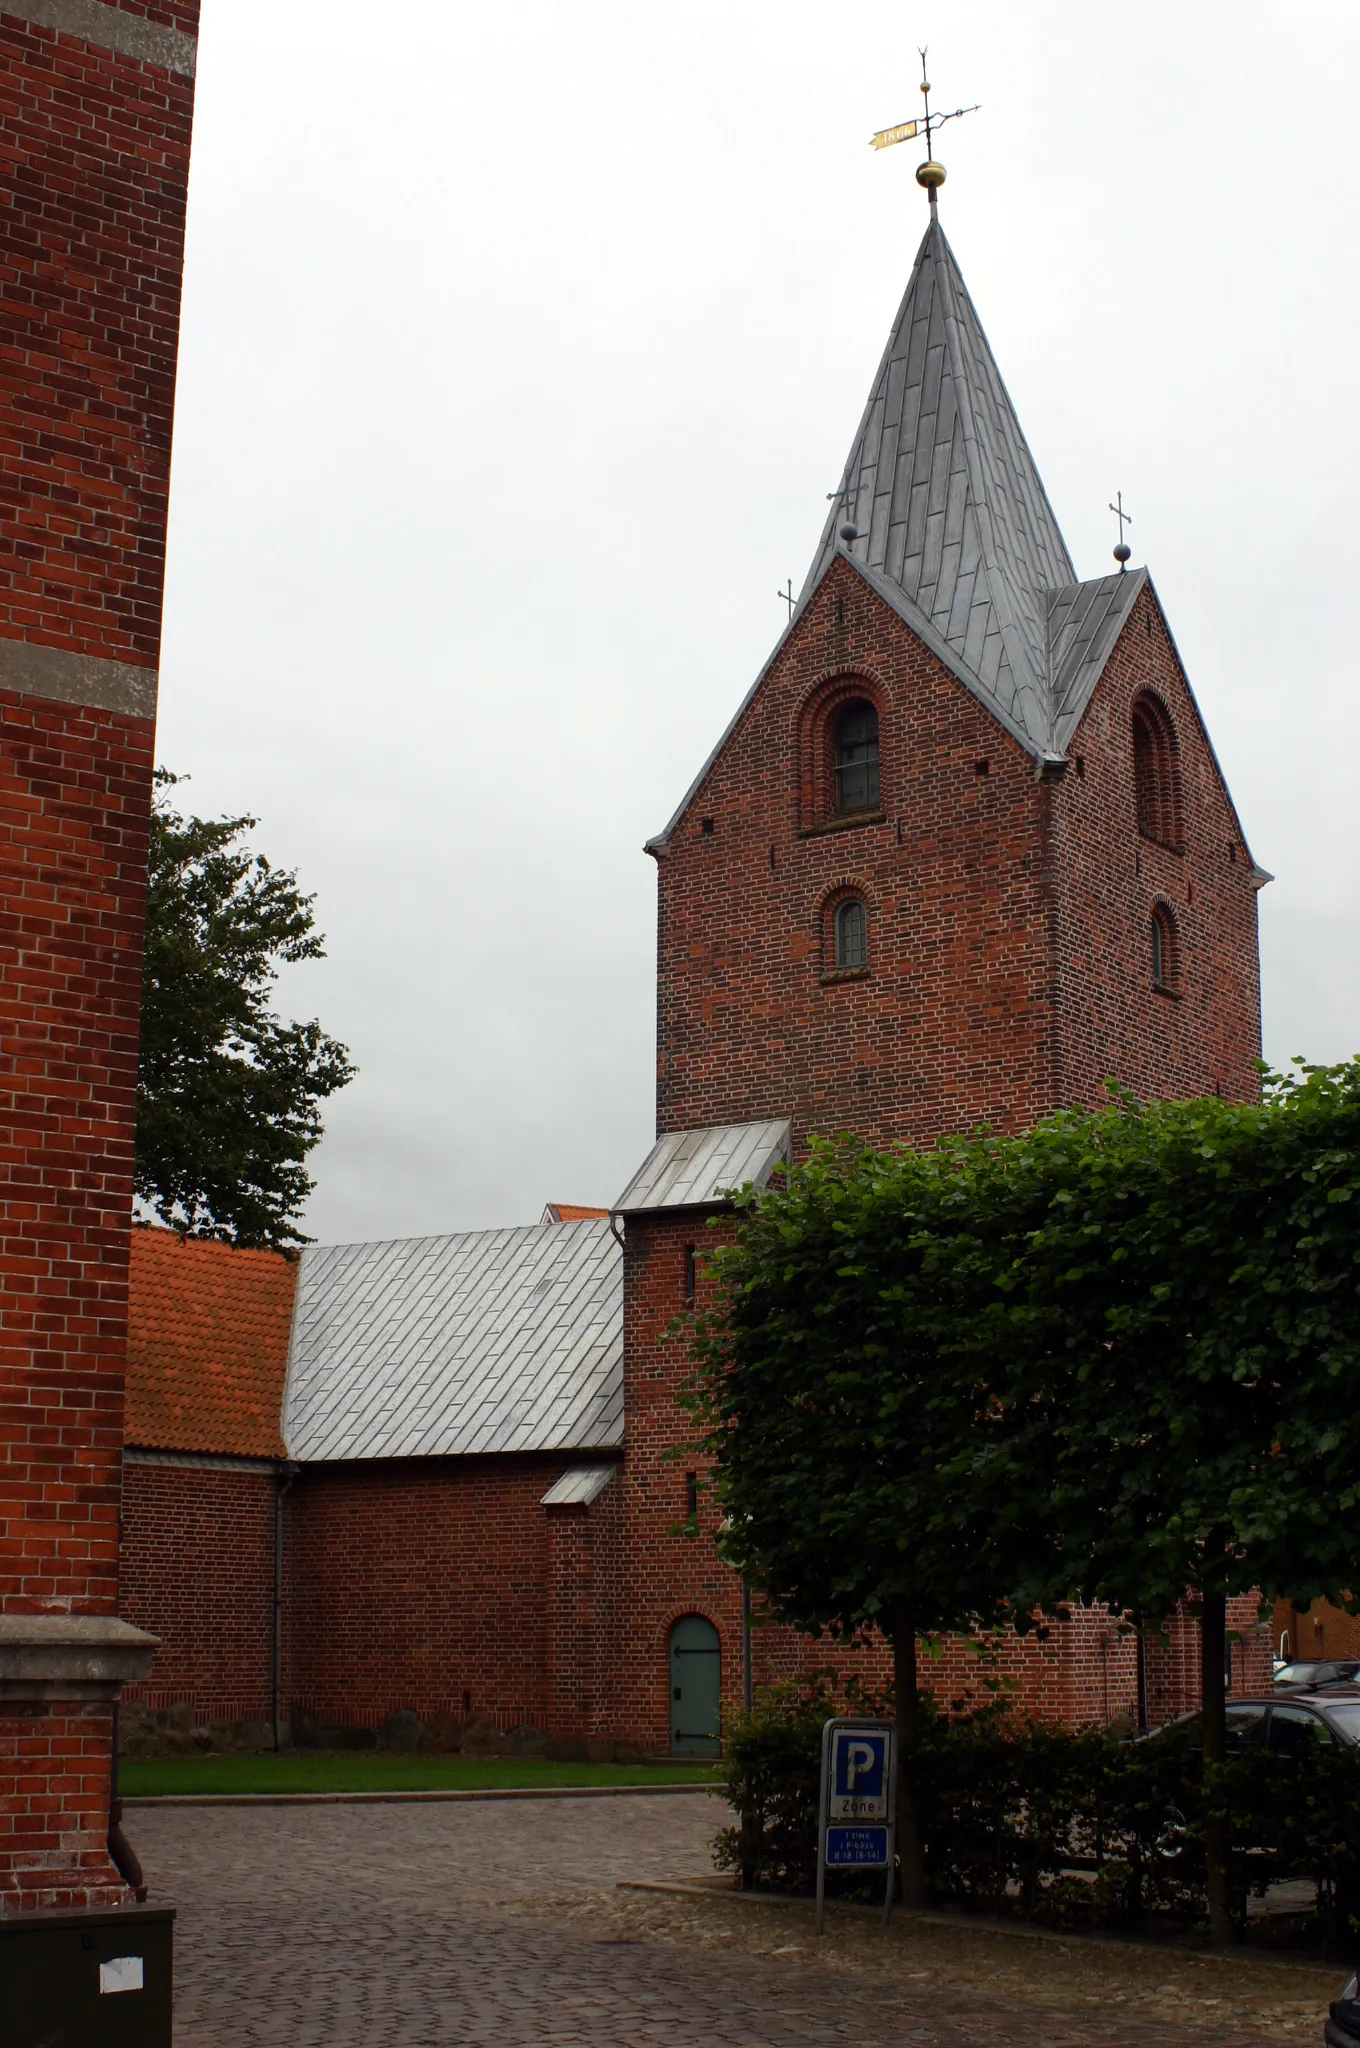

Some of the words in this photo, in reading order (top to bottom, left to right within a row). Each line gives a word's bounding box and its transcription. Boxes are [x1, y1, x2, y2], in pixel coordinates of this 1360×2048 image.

[847, 1742, 875, 1789] P
[842, 1799, 875, 1812] Zone
[852, 1831, 870, 1840] time
[834, 1851, 852, 1860] 8-18
